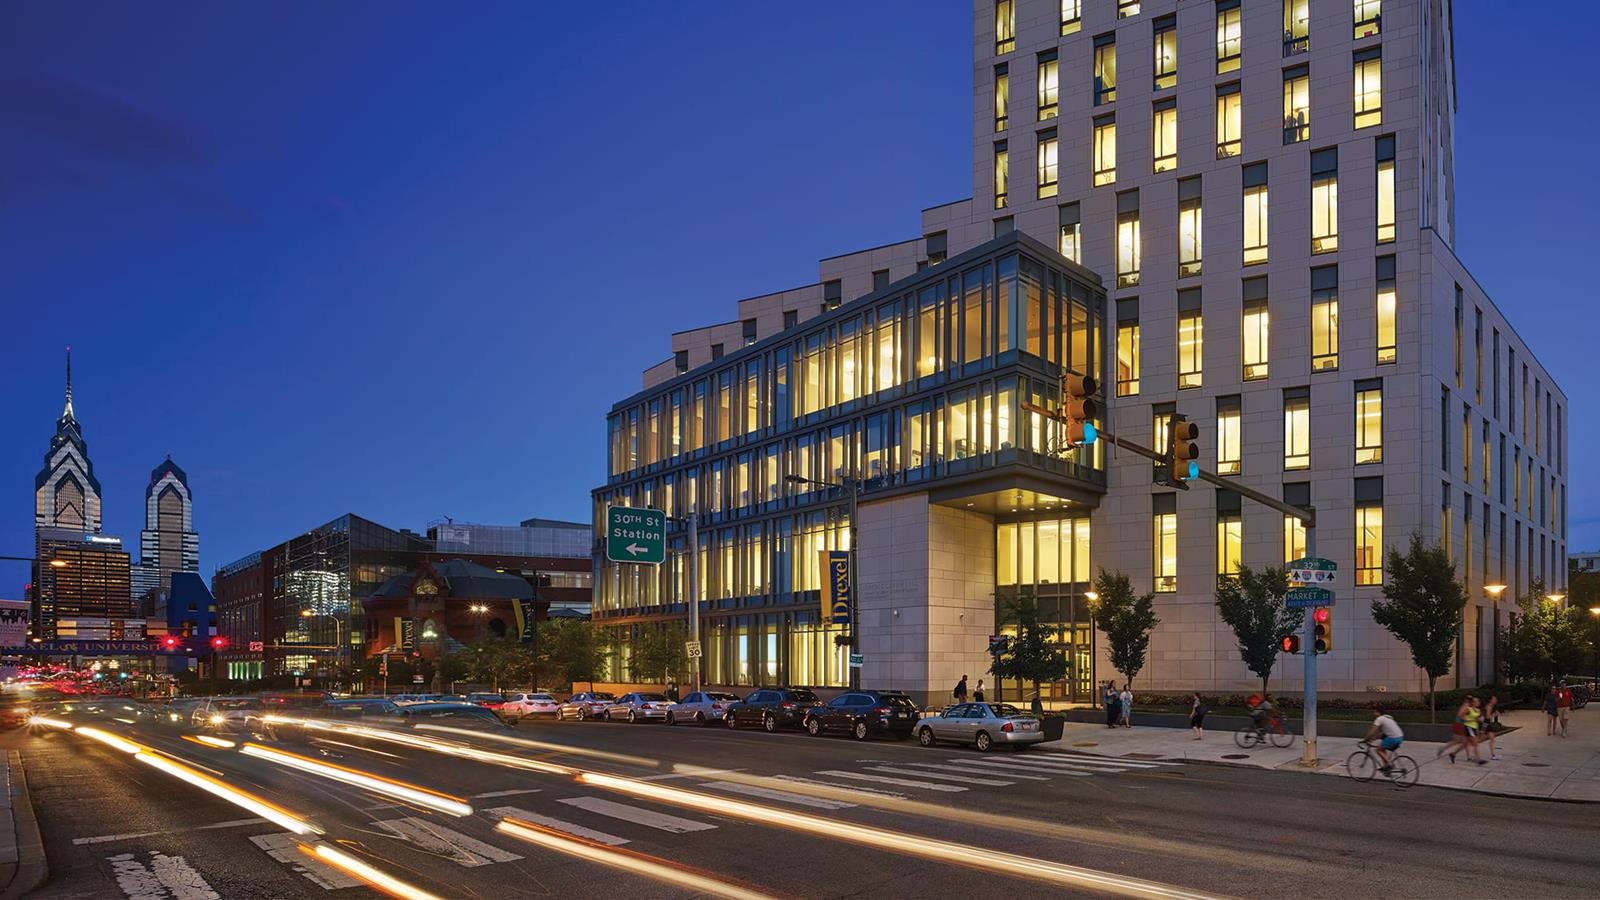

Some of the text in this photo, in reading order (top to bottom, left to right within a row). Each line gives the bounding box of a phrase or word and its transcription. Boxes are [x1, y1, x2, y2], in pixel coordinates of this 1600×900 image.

[614, 514, 660, 527] 30TH St
[614, 528, 660, 540] Station
[831, 558, 849, 617] Drexel
[1287, 592, 1317, 600] MARKET
[401, 620, 414, 649] Drexel
[85, 643, 164, 651] UNIVERSIT
[689, 649, 700, 657] 30
